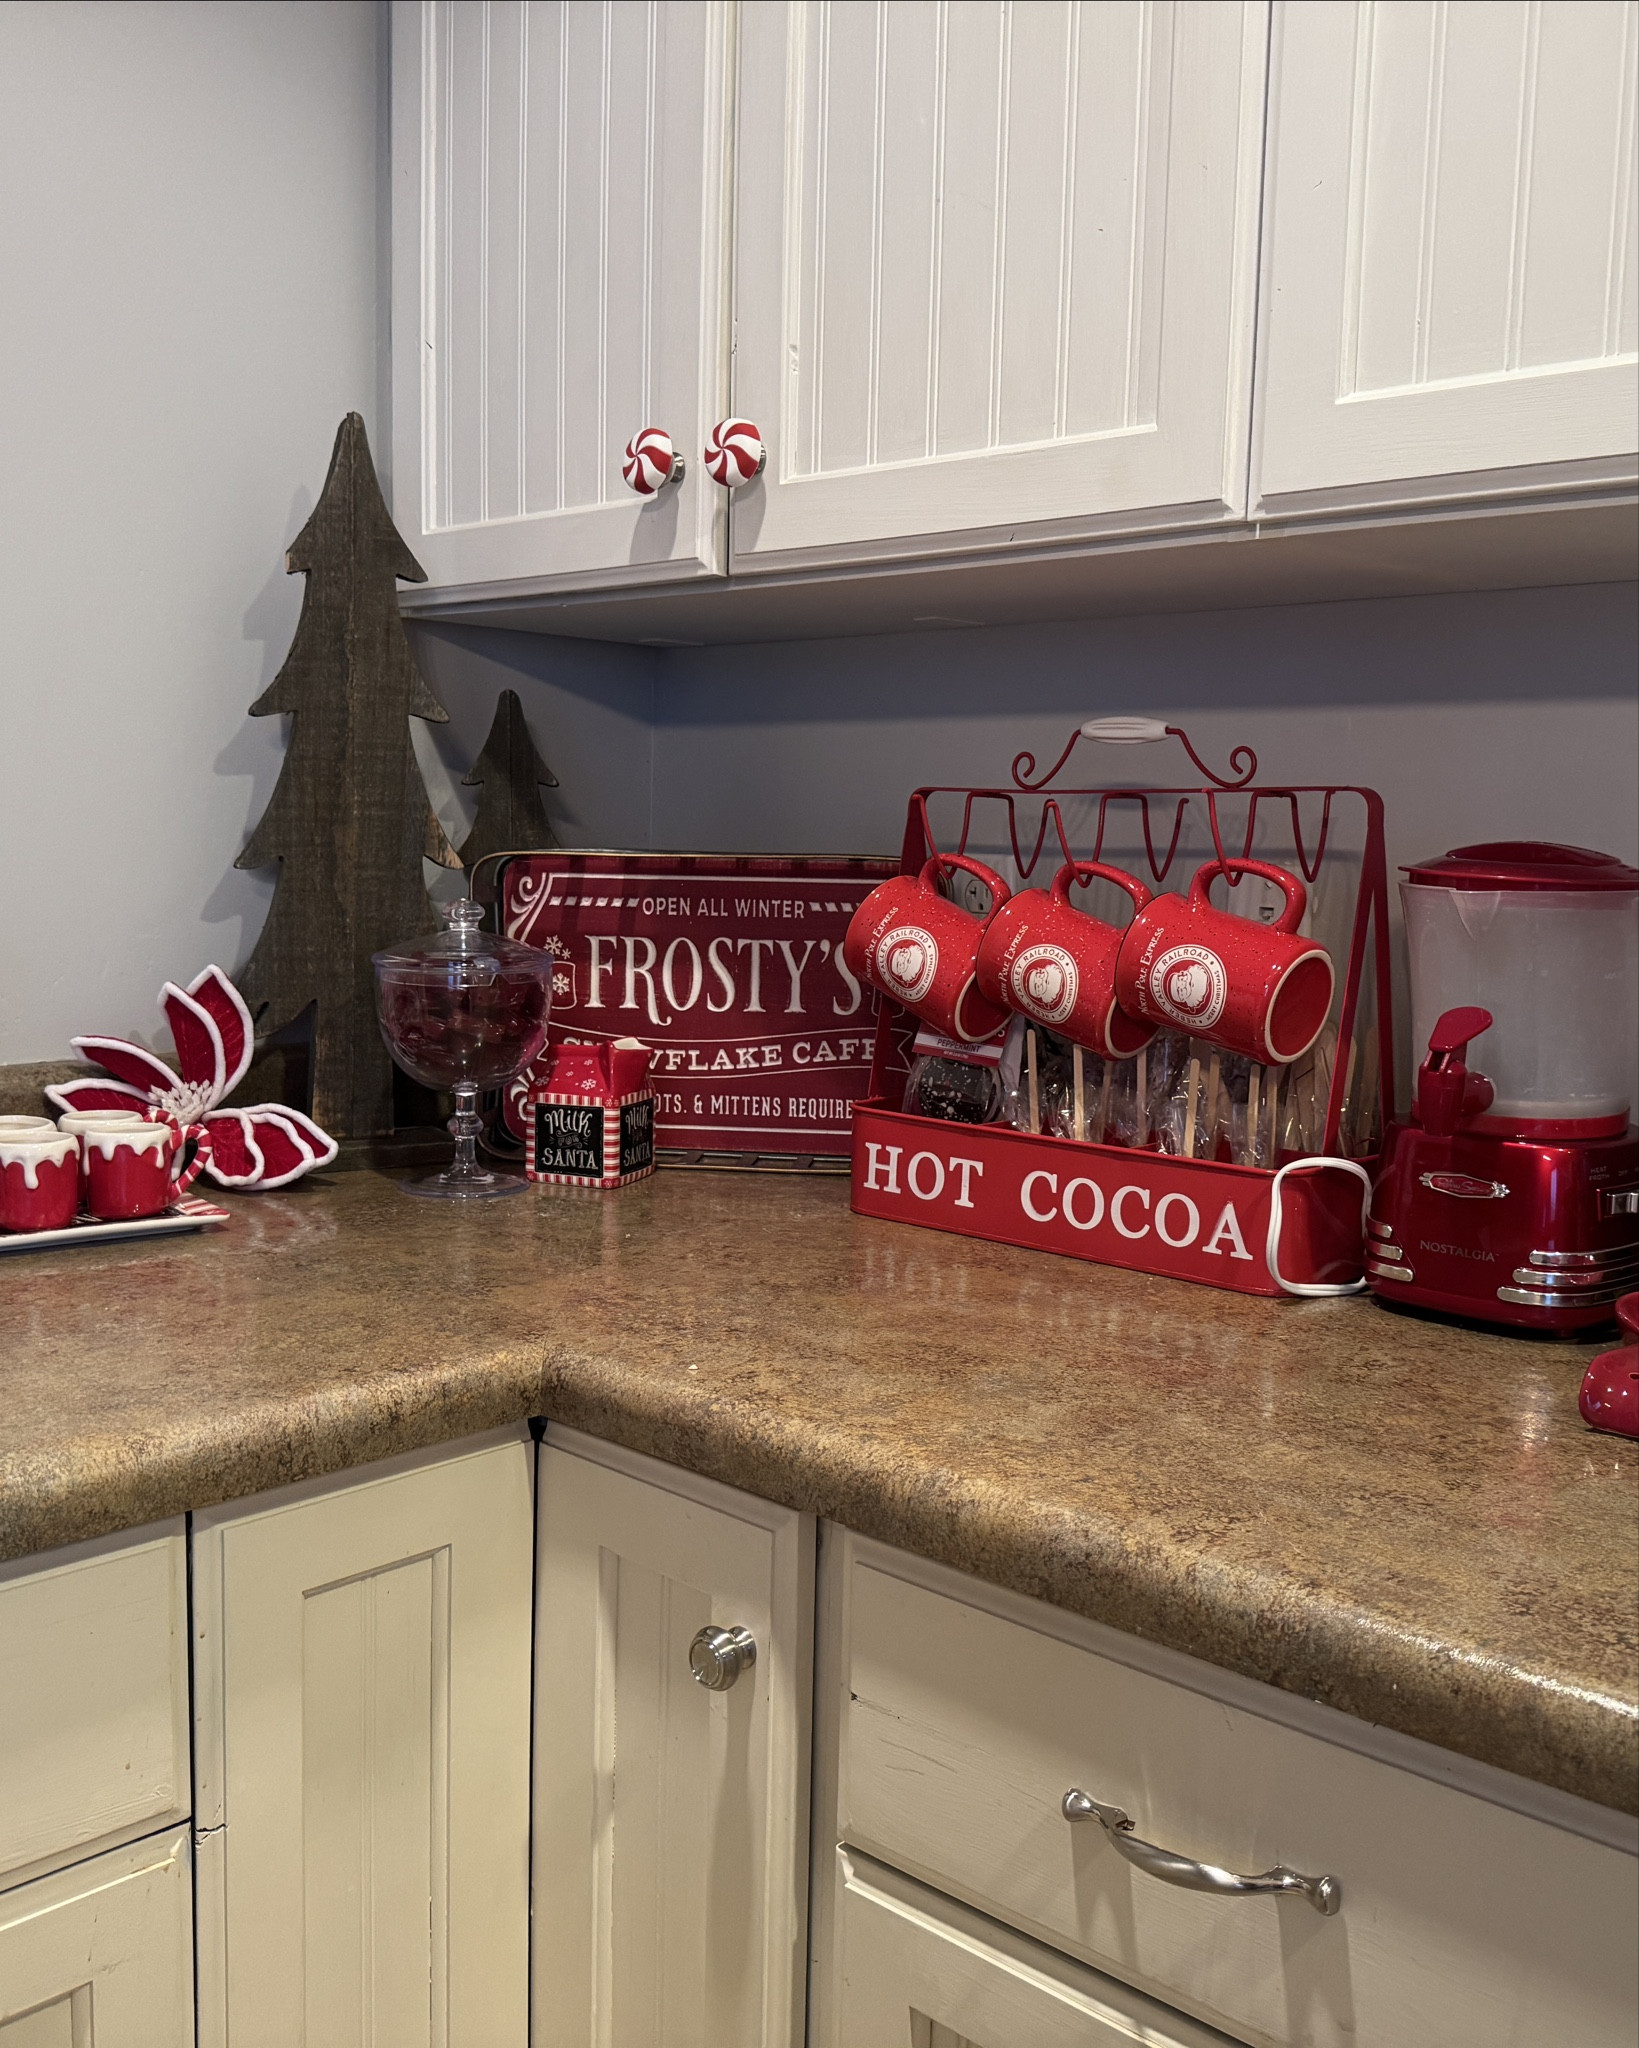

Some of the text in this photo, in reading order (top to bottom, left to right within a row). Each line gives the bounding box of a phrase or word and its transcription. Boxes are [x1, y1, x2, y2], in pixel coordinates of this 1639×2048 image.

[642, 897, 804, 919] OPEN ALL WINTER
[889, 929, 930, 944] RAILROAD
[1139, 927, 1165, 966] EXPRESS
[1023, 948, 1066, 963] RAILROAD
[584, 935, 862, 1026] FROSTY'S
[1153, 968, 1165, 1007] VALLEY
[1161, 948, 1209, 967] RAILROAD
[936, 1038, 982, 1053] PEPPERMINT
[693, 1094, 704, 1115] &
[710, 1095, 781, 1118] MITTENS
[788, 1097, 858, 1120] REQUIRE
[541, 1147, 599, 1170] SANTA
[623, 1141, 652, 1167] SANTA
[863, 1141, 1254, 1261] HOT COCOA
[1420, 1240, 1496, 1263] NOSTALGIA
